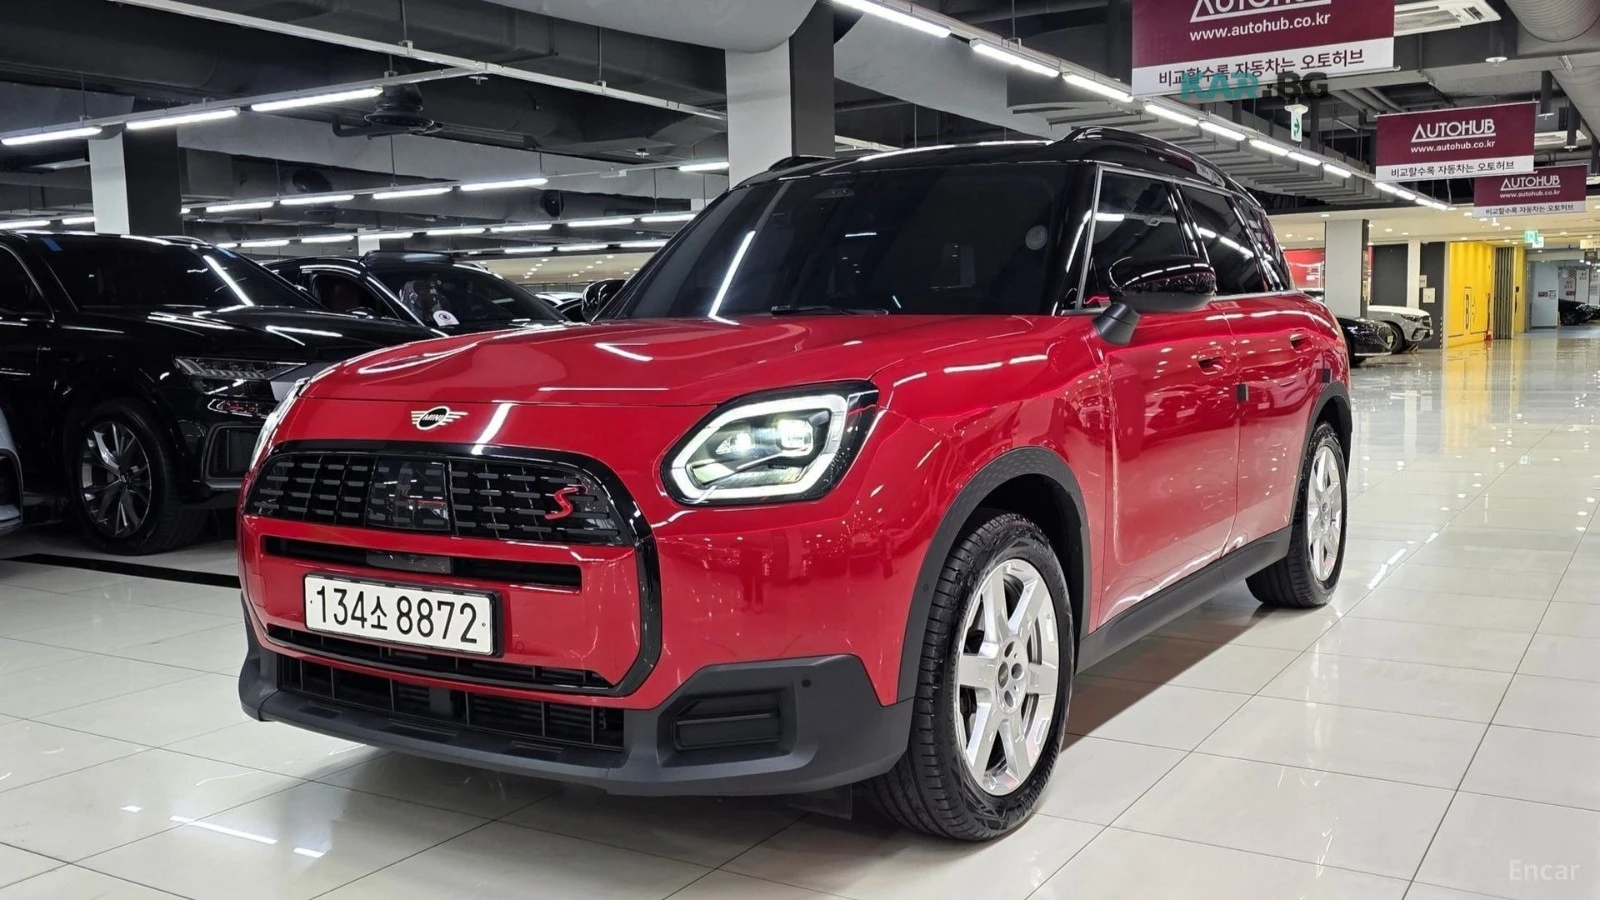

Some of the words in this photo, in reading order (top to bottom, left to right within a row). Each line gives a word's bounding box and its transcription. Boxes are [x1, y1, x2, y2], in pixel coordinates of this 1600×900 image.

[1189, 12, 1331, 41] www.autohub.co.kr
[1235, 57, 1296, 78] 자동차는
[1300, 48, 1365, 71] 오토허브
[1411, 118, 1496, 143] AUTOHUB
[1410, 140, 1496, 154] www.autohub.co.kr
[1390, 166, 1435, 178] 비교할수록
[1438, 164, 1475, 176] 자동차는
[1477, 161, 1516, 172] 오토허브
[1500, 175, 1561, 191] AUTOHUB
[316, 585, 388, 631] 134소
[396, 595, 478, 644] 8872
